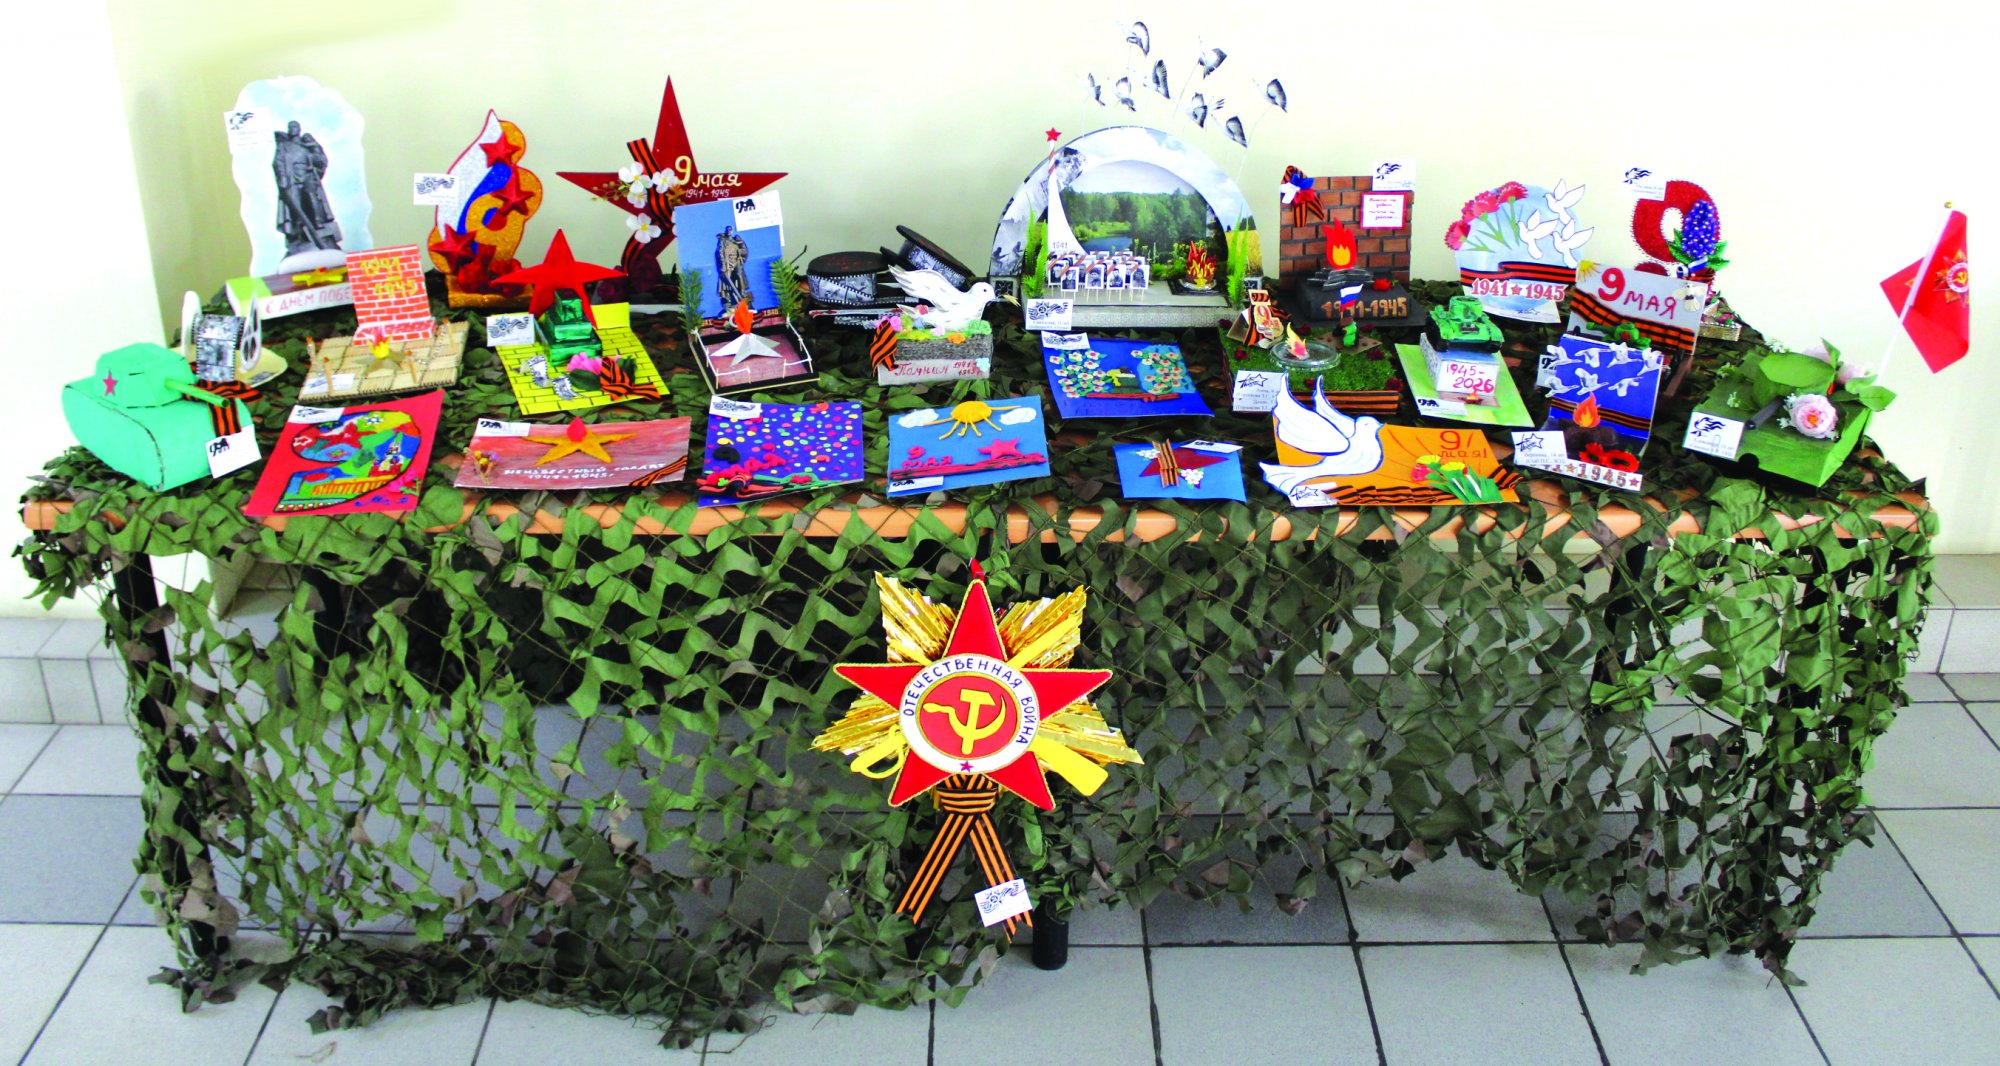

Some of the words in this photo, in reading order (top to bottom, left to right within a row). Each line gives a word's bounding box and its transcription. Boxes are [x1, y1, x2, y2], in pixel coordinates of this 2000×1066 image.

[675, 155, 692, 185] 9
[692, 173, 742, 188] мая
[685, 188, 704, 198] 1941
[710, 188, 731, 198] 1945
[1052, 241, 1068, 249] 1941
[1471, 277, 1509, 297] 1941
[1525, 281, 1565, 301] 1945
[1598, 267, 1626, 302] 9
[1623, 290, 1678, 320] МАЯ
[265, 299, 274, 314] С
[279, 290, 316, 312] ДНЁМ
[895, 362, 949, 376] Помним
[1446, 363, 1485, 376] 1945-
[1453, 376, 1495, 393] 2026
[908, 445, 925, 460] 9
[1577, 463, 1628, 488] 1945
[903, 658, 1023, 716] ОТЕЧЕСТВЕННАЯ
[1015, 696, 1038, 745] ВОЙНА
